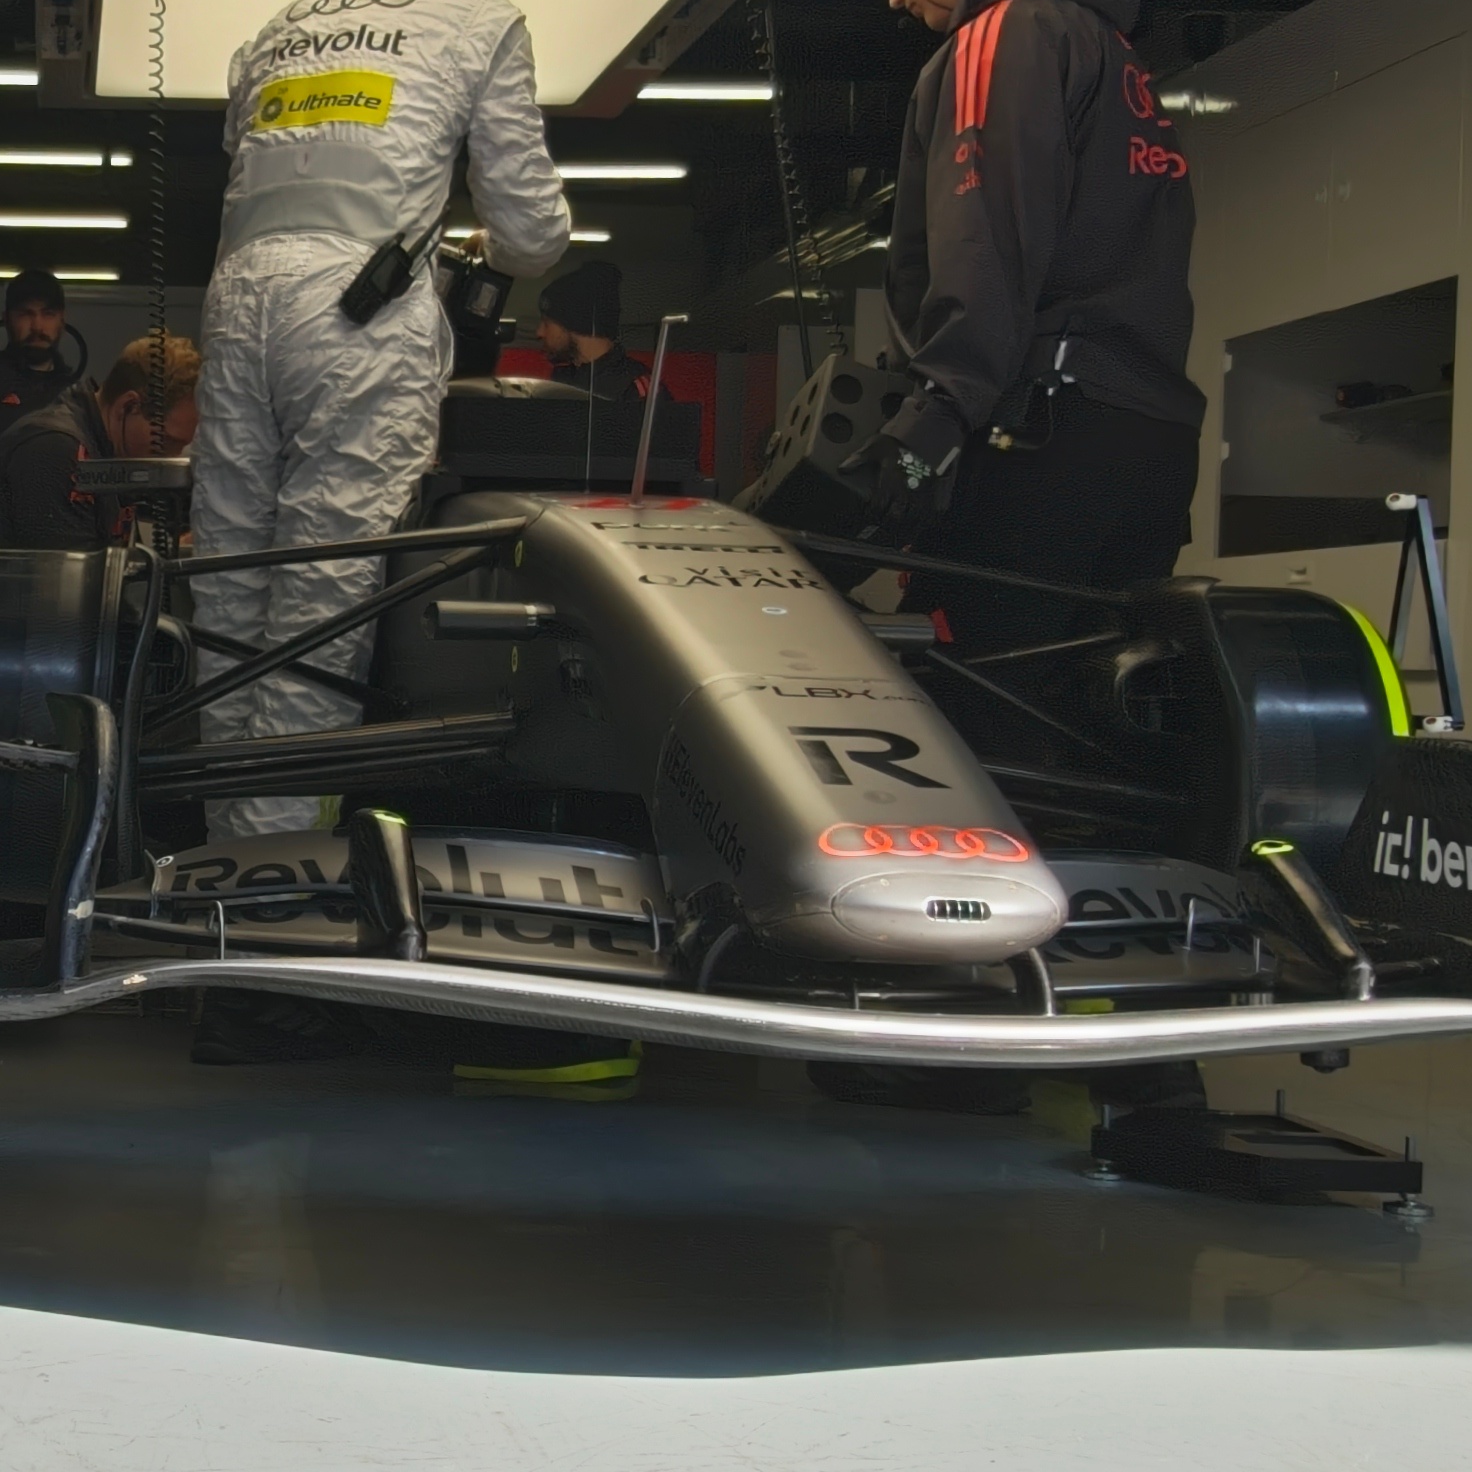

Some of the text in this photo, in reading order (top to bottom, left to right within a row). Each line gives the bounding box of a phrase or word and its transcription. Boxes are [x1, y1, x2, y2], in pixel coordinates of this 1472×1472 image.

[268, 23, 409, 68] Revolut
[287, 90, 383, 114] ultimate
[637, 572, 827, 591] QATAR
[786, 725, 953, 789] R
[1373, 810, 1413, 881] ic!
